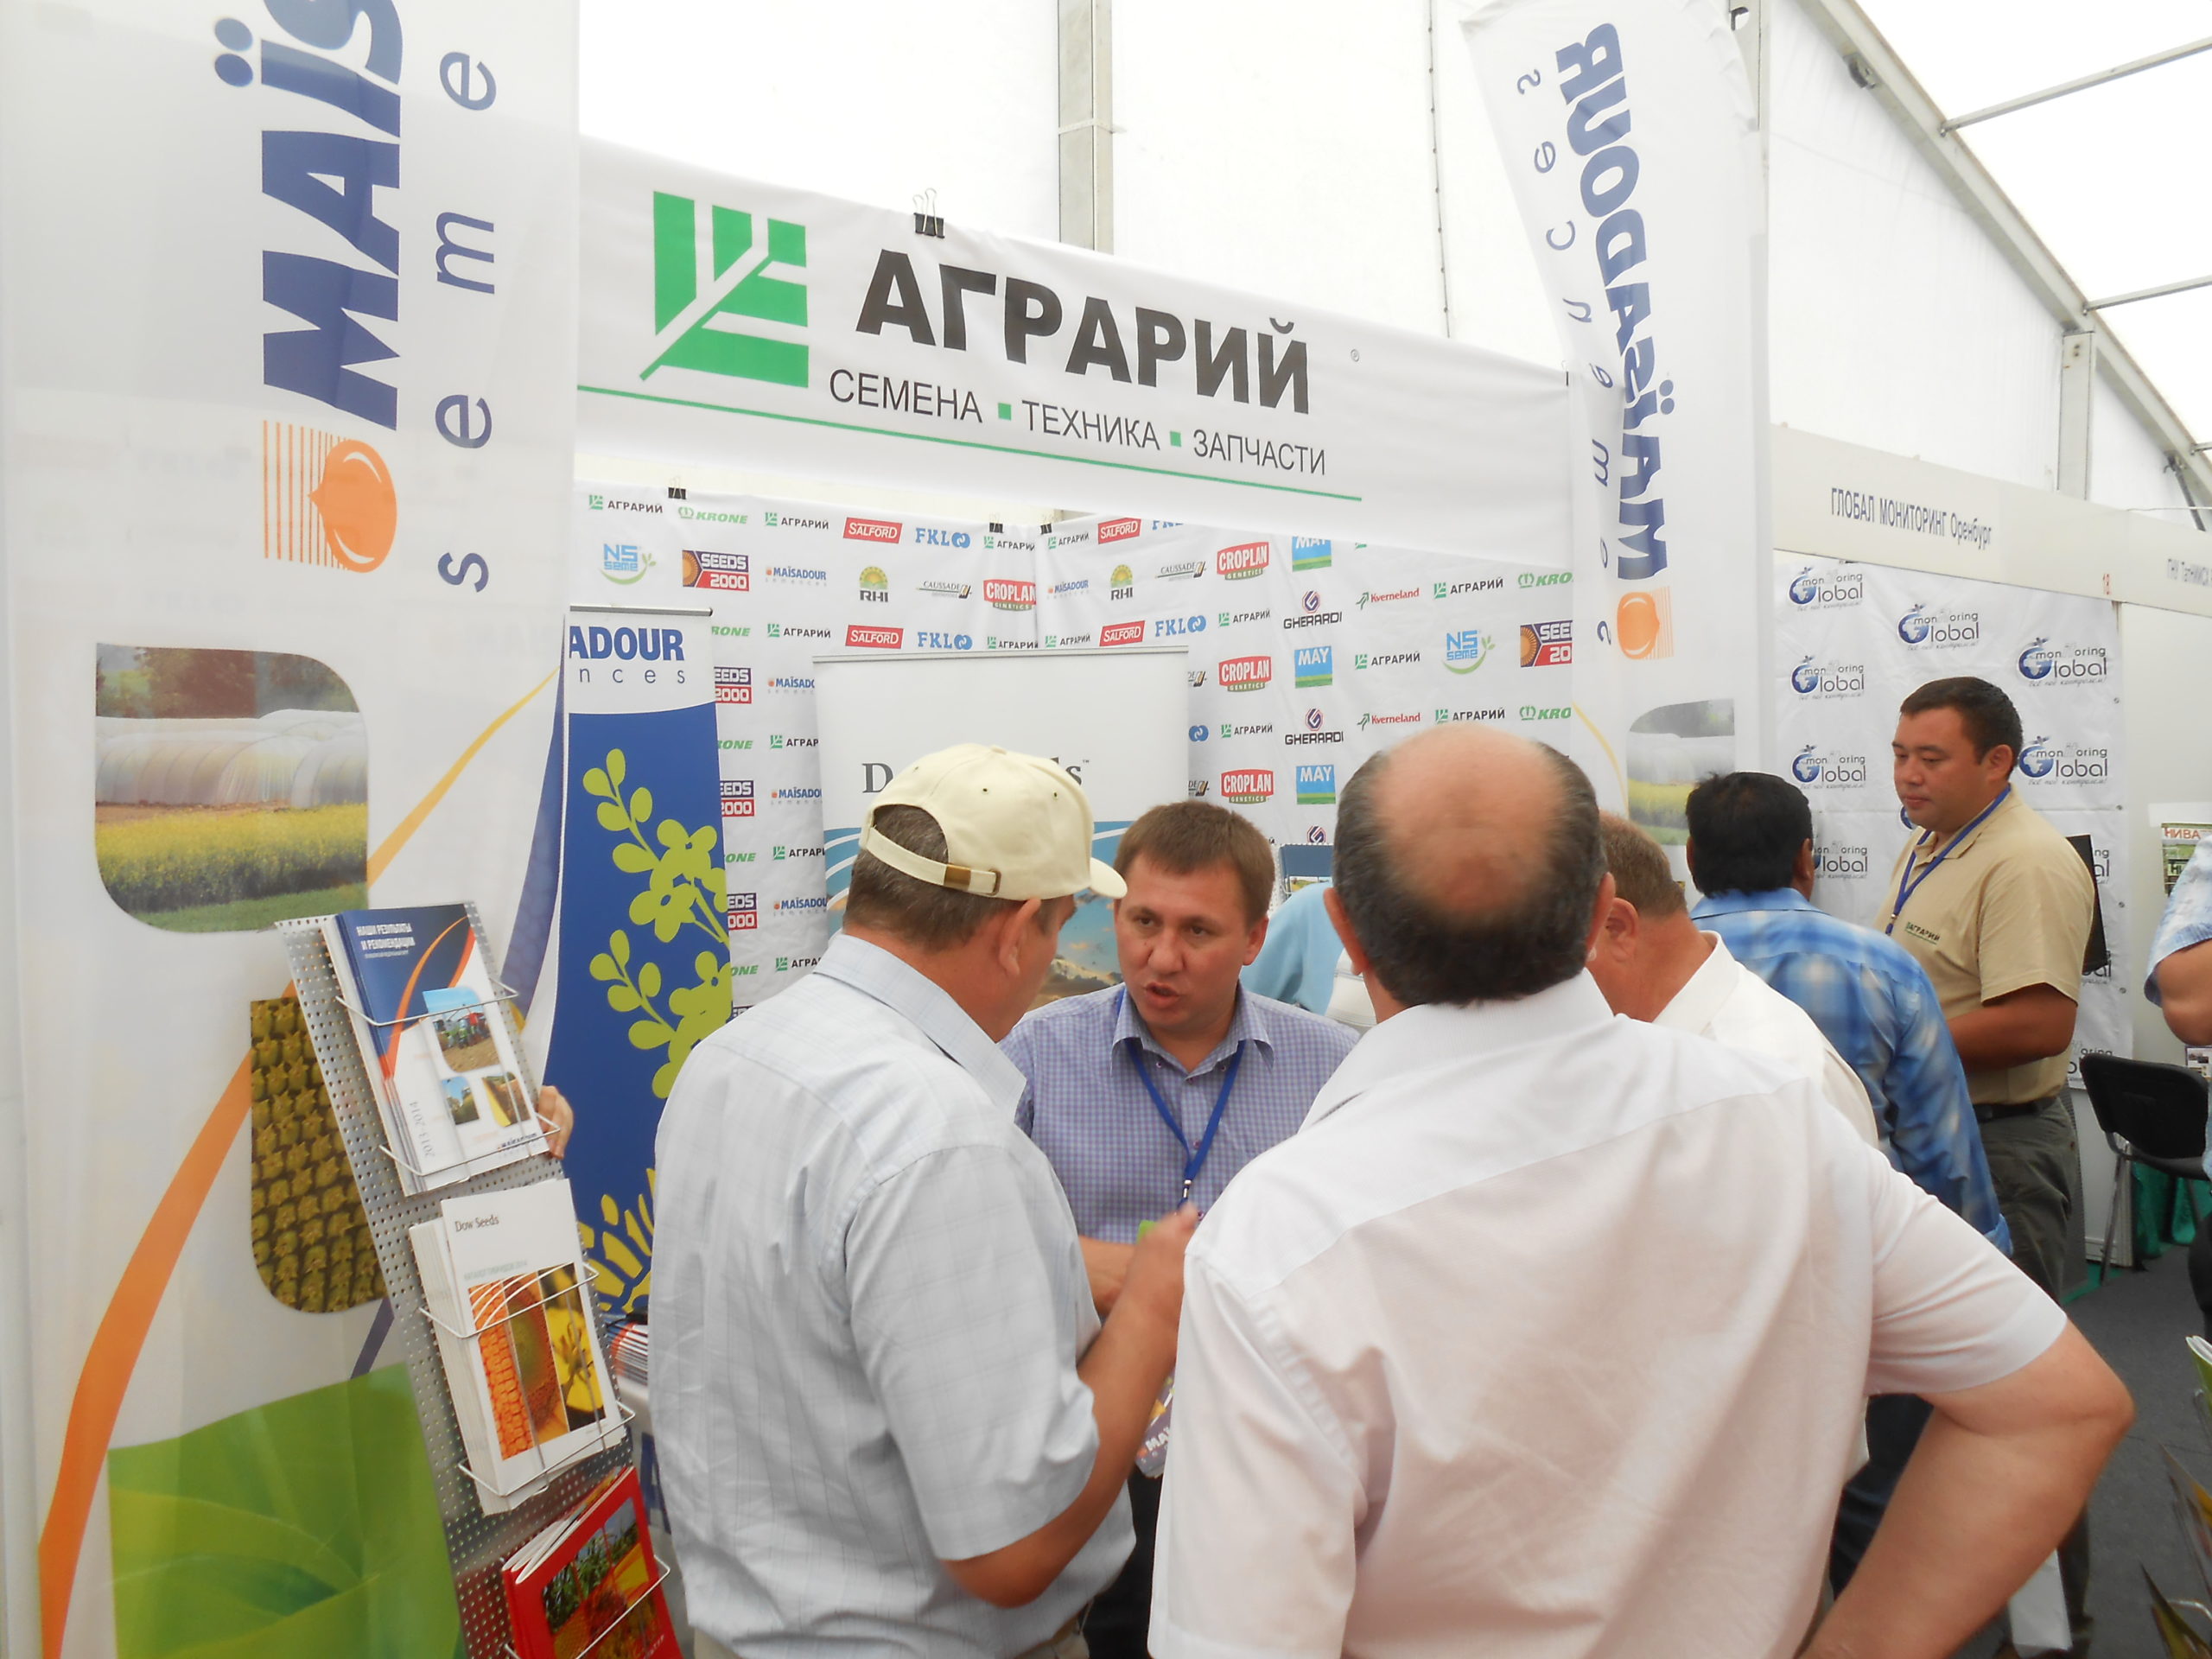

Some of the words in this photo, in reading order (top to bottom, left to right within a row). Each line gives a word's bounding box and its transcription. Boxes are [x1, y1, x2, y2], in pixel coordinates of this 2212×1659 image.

[213, 0, 403, 431] MAÏS
[855, 249, 1310, 414] АГРАРИЙ
[830, 368, 982, 423] СЕМЕНА
[1021, 400, 1161, 451] ТЕХНИКА
[1192, 429, 1325, 476] ЗАПЧАСТИ
[607, 499, 664, 514] АГРАРИЙ
[696, 512, 748, 524] KRONE
[781, 517, 829, 530] АГРАРИЙ
[1831, 487, 1875, 523] ГЛОБАЛ
[1878, 498, 1948, 537] МОНИТОРИНГ
[1950, 512, 1992, 550] Оренбург
[848, 522, 898, 540] SALFORD
[915, 527, 950, 546] FKL
[1100, 520, 1138, 539] SALFORD
[1058, 533, 1090, 546] АГРАРИЙ
[603, 543, 639, 562] NS
[1218, 545, 1268, 571] CROPLAN
[701, 553, 747, 570] SEEDS
[773, 566, 827, 580] MAÏSADOUR
[1535, 572, 1573, 587] KRO
[709, 574, 747, 589] 2000
[923, 581, 961, 591] CAUSSADE
[1450, 578, 1503, 594] АГРАРИЙ
[860, 590, 888, 602] RHI
[987, 583, 1037, 602] CROPLAN
[1110, 587, 1134, 601] RHI
[1370, 588, 1420, 603] Kverneland
[1232, 610, 1270, 623] АГРАРИЙ
[1283, 612, 1342, 629] GHERARDI
[712, 627, 751, 637] RONE
[784, 627, 831, 638] АГРАРИЙ
[1103, 625, 1141, 643] SALFORD
[1155, 619, 1186, 638] FKL
[1540, 623, 1571, 640] SEE
[569, 626, 685, 661] ADOUR
[850, 631, 899, 645] SALFORD
[918, 632, 953, 649] FKL
[1060, 633, 1090, 645] АГРАРИЙ
[1446, 631, 1478, 651] NS
[1299, 648, 1329, 665] MAY
[1371, 653, 1421, 665] АГРАРИЙ
[1549, 646, 1571, 663] 20
[580, 667, 685, 683] nces
[715, 668, 749, 683] EEDS
[1221, 660, 1269, 683] CROPLAN
[1371, 713, 1421, 724] Kverneland
[1452, 709, 1505, 721] АГРАРИЙ
[1537, 707, 1571, 720] KRO
[1234, 724, 1273, 734] АГРАРИЙ
[786, 738, 819, 747] АГРАР
[1285, 732, 1344, 745] GHERARDI
[1300, 766, 1332, 782] MAY
[720, 781, 753, 796] EEDS
[1224, 774, 1272, 792] CROPLAN
[779, 787, 821, 798] MAÏSADO
[1230, 795, 1266, 804] GENETICS
[2164, 827, 2202, 840] НИВА
[725, 853, 756, 862] ONE
[1815, 855, 1867, 873] lobal
[728, 894, 755, 908] EDS
[781, 898, 827, 910] MAÏSADOU
[728, 914, 756, 928] 000
[731, 965, 759, 976] ONE
[791, 958, 821, 969] АГРА
[454, 1218, 474, 1233] Dow
[475, 1213, 499, 1230] Seeds
